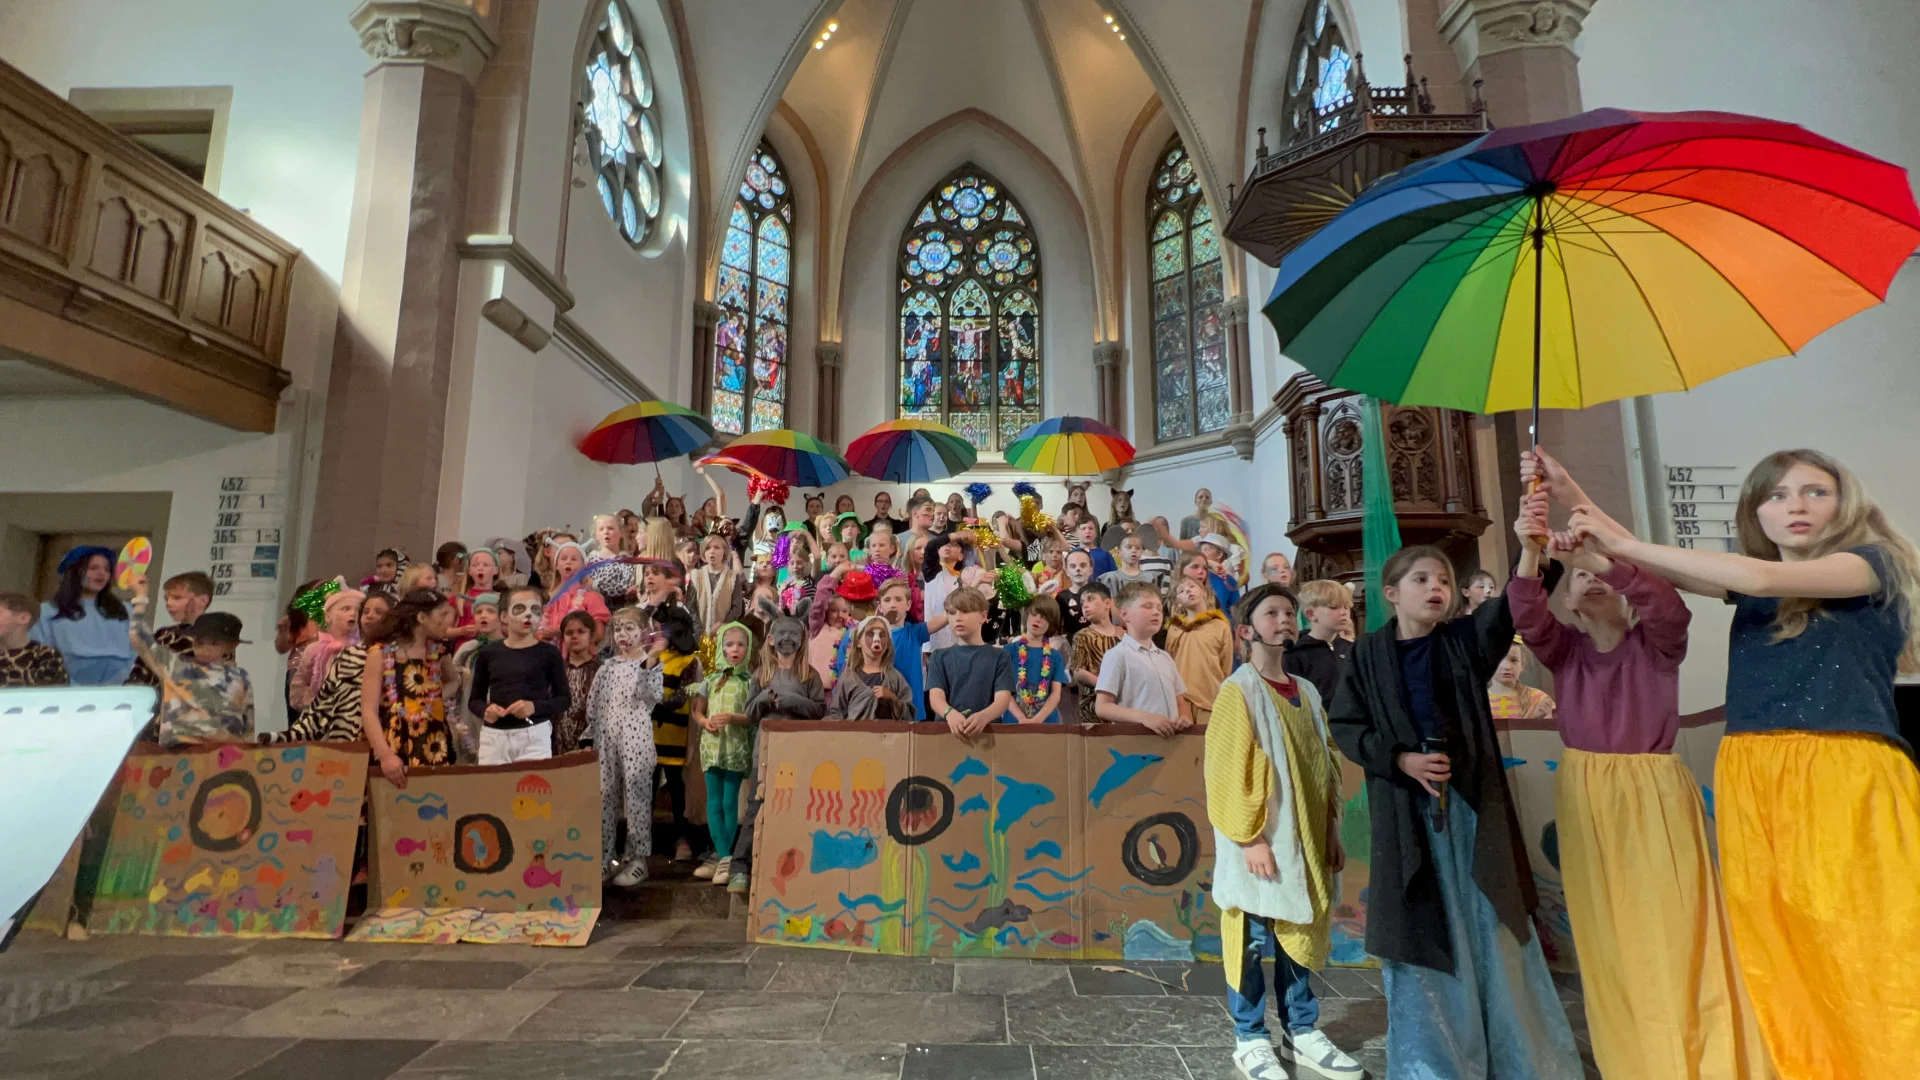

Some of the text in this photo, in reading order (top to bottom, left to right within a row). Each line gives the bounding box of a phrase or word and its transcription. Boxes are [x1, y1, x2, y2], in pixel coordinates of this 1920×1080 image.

[1669, 467, 1693, 482] 452
[221, 477, 243, 491] 452
[1671, 485, 1725, 500] 717 1
[219, 495, 265, 510] 717 1
[1672, 503, 1698, 517] 382
[217, 513, 241, 527] 382
[1676, 520, 1700, 535] 365
[213, 530, 236, 544] 365
[210, 547, 224, 560] 91
[210, 564, 233, 578] 155
